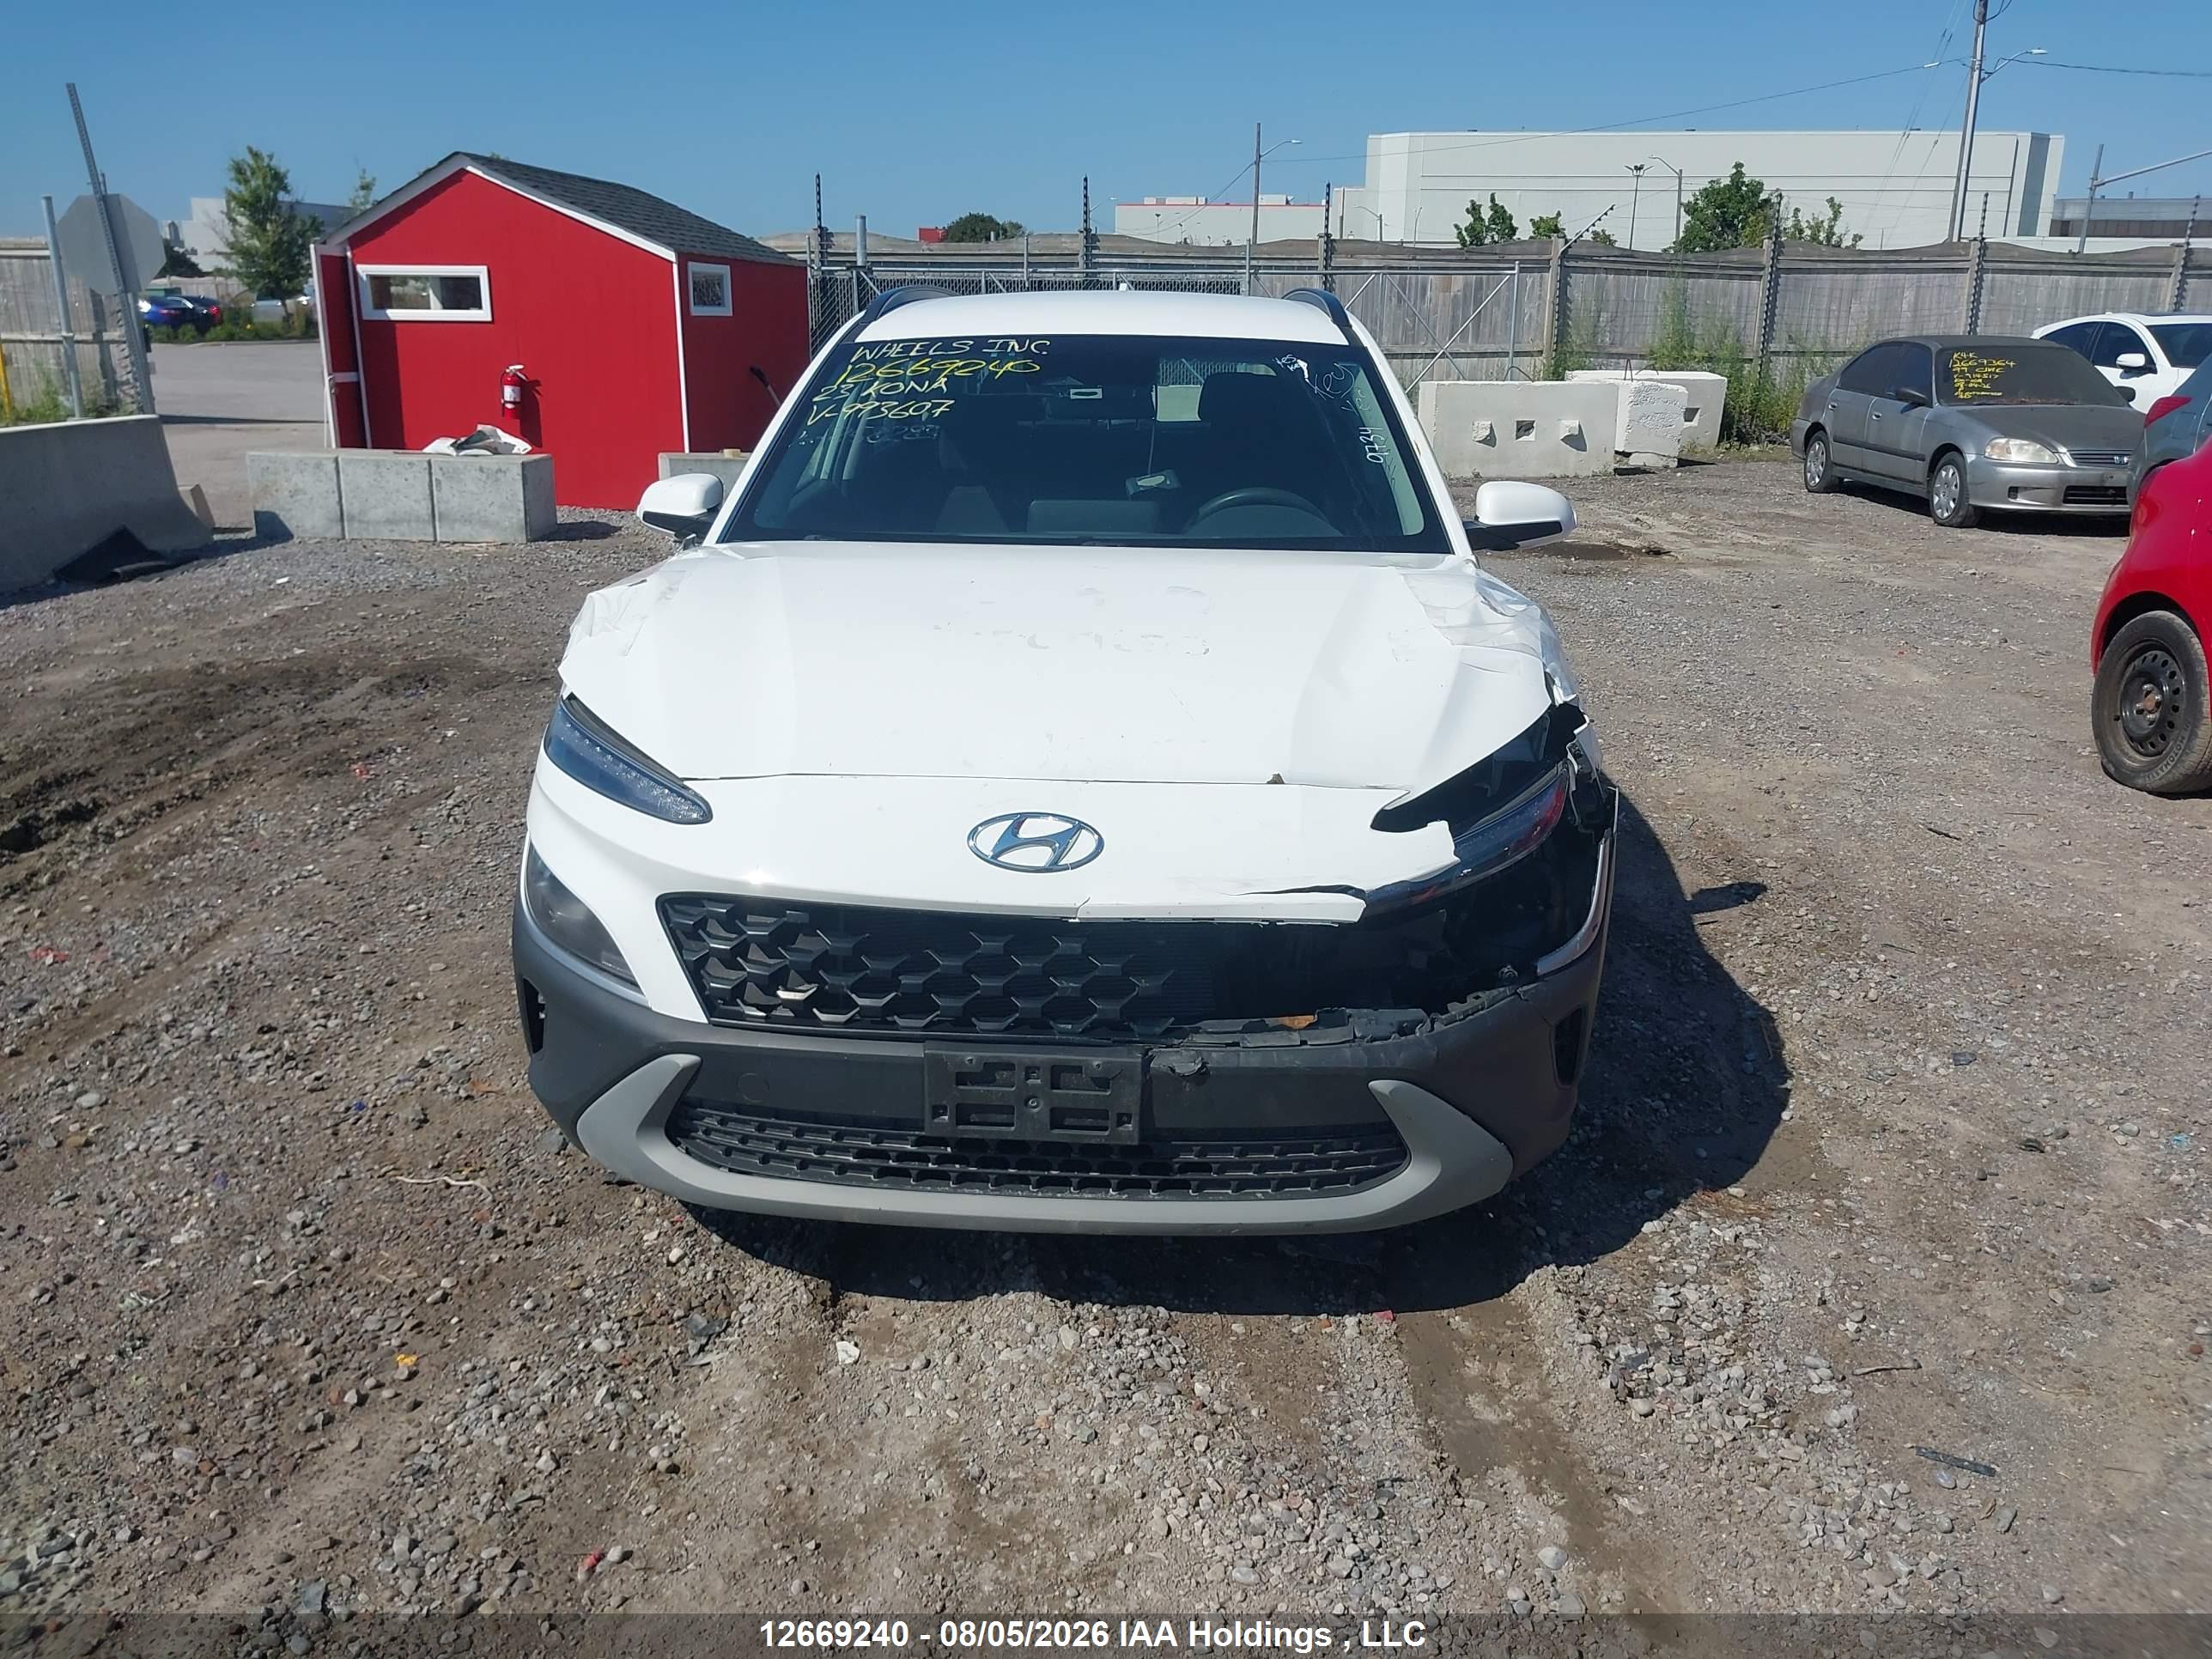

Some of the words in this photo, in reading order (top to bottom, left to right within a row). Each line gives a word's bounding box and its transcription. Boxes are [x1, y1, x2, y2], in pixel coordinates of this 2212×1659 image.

[850, 341, 975, 362] WHEELS
[836, 357, 1041, 386] 12669240
[812, 384, 854, 402] 23
[860, 378, 948, 398] KONA
[807, 400, 956, 426] V-993607
[1358, 427, 1389, 463] 9734
